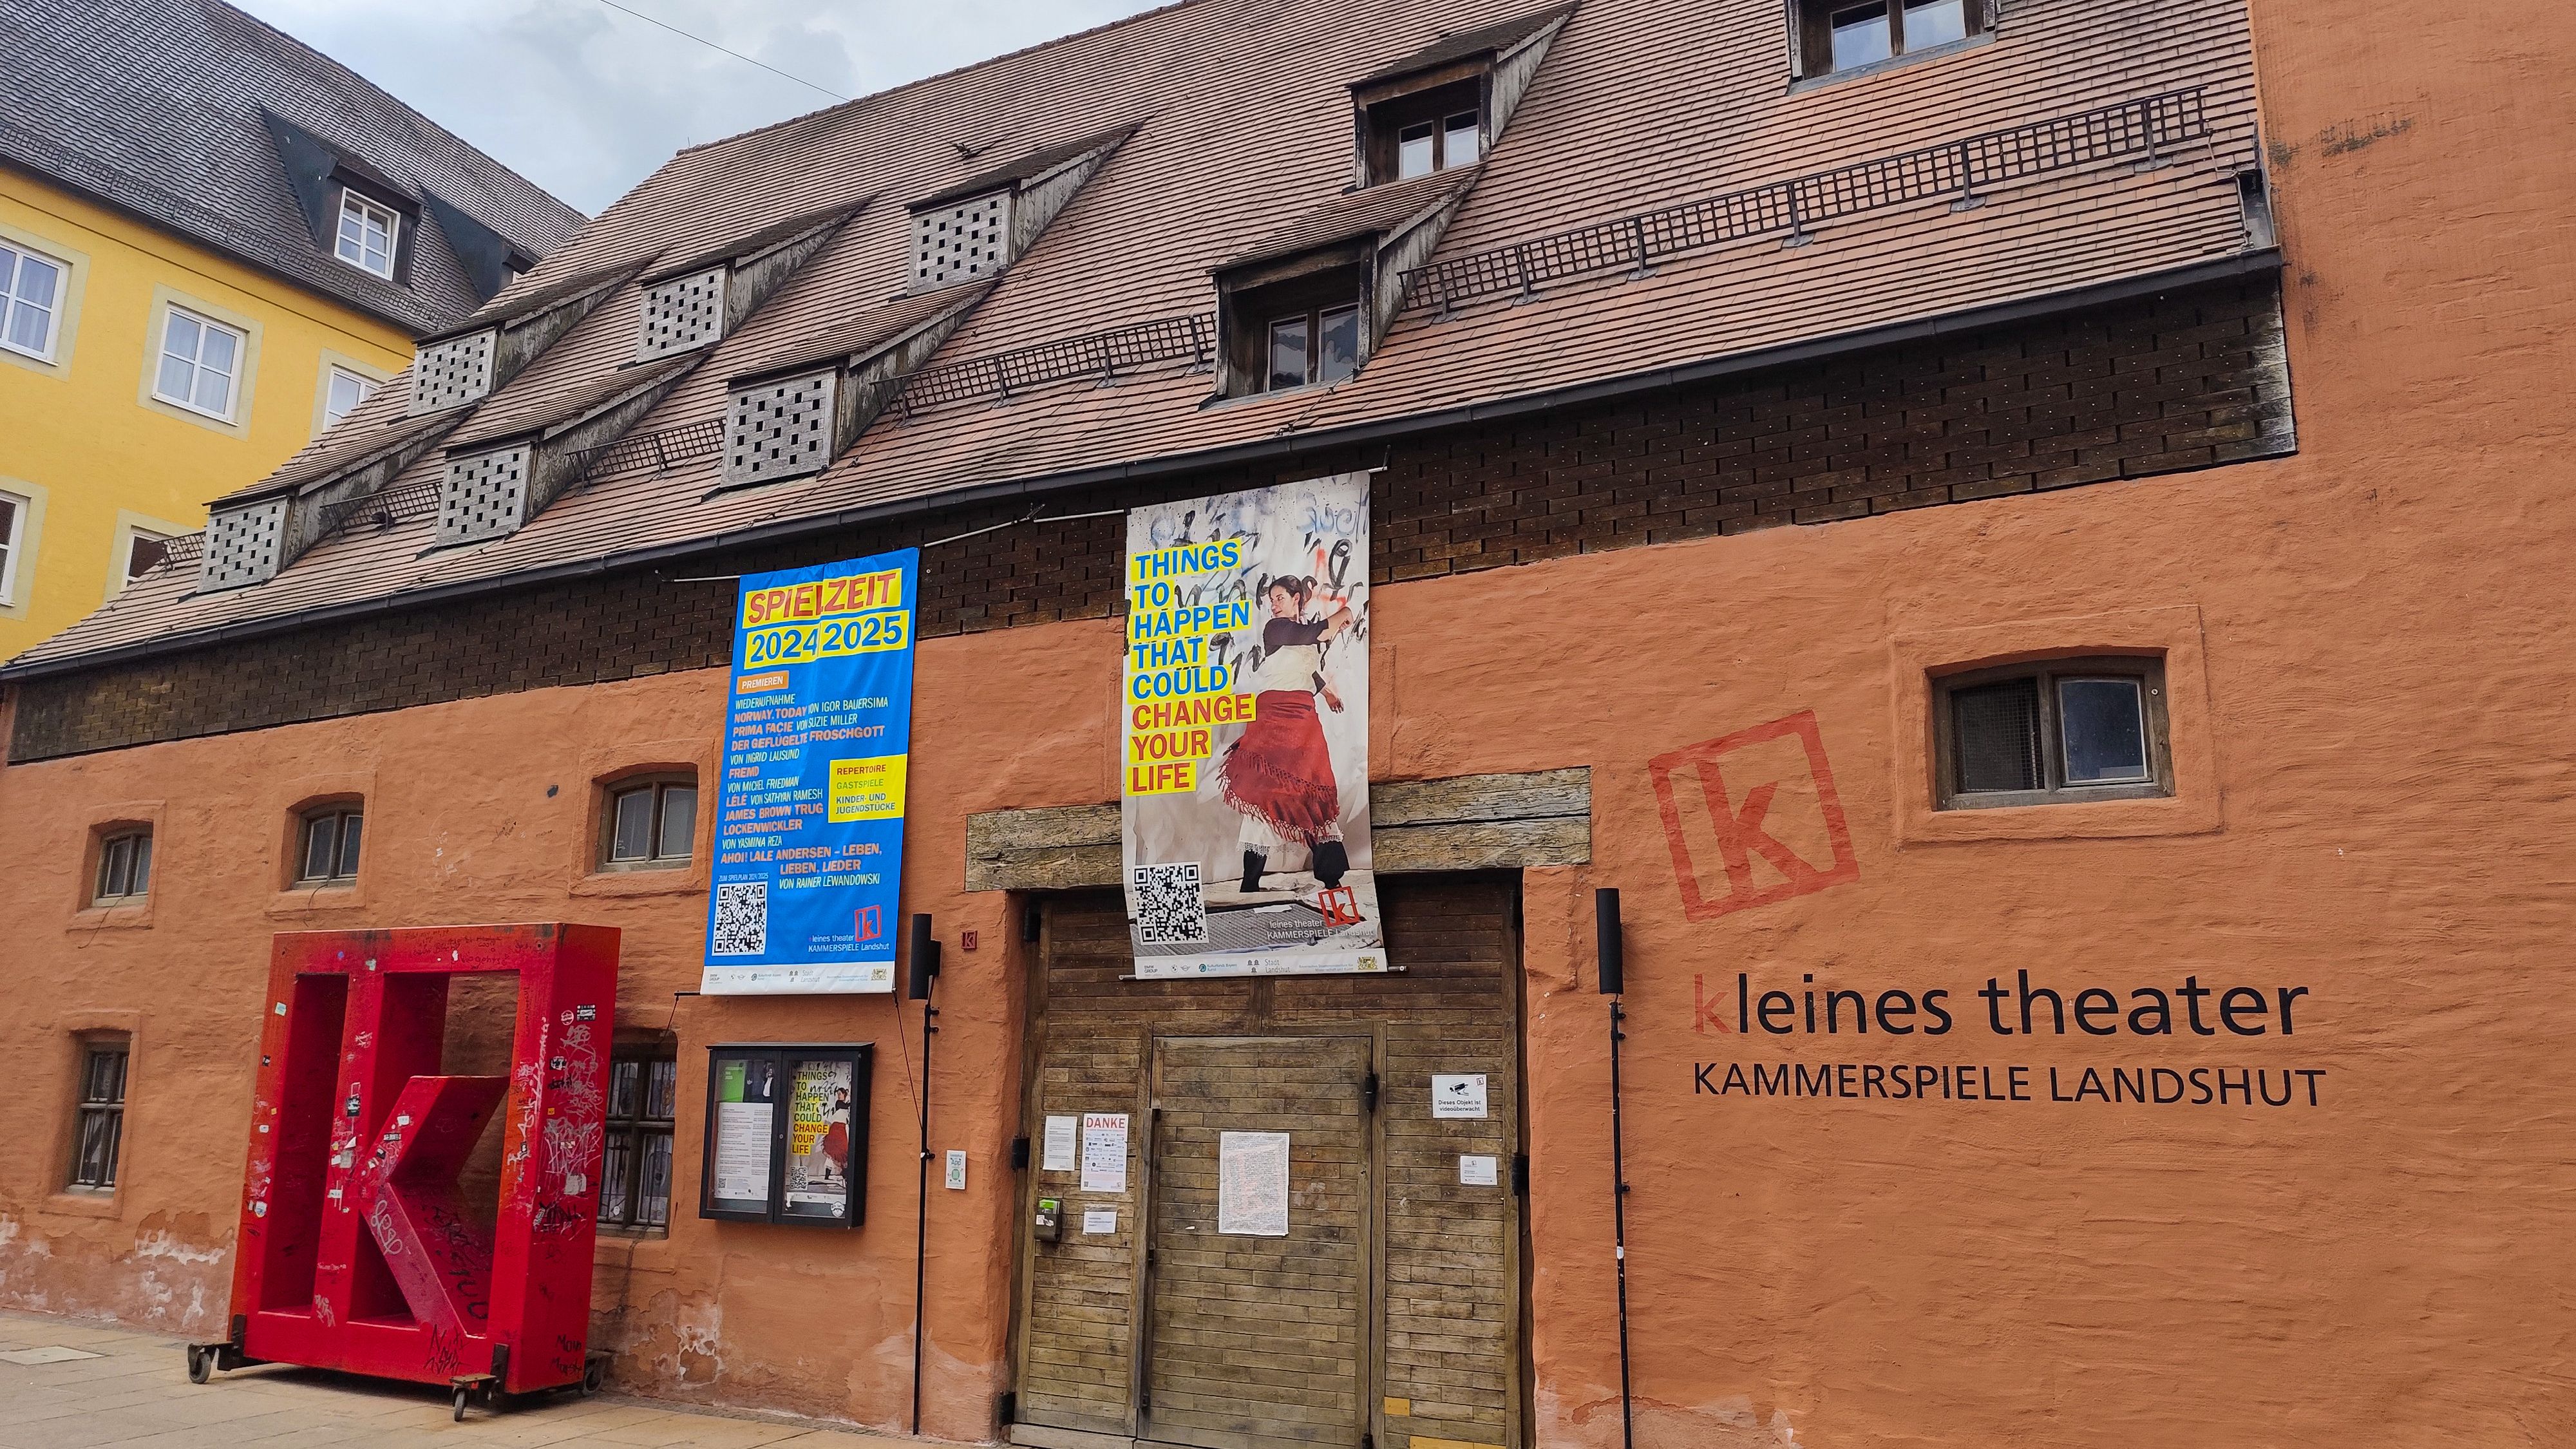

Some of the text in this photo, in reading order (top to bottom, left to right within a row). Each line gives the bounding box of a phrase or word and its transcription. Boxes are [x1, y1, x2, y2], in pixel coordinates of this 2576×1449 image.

[1135, 542, 1239, 579] THINGS
[1135, 585, 1170, 609] TO
[1135, 601, 1249, 639] HAPPEN
[1133, 638, 1203, 668] THAT
[742, 676, 783, 689] PREMIEREN
[1133, 667, 1227, 699] COULD
[735, 694, 796, 710] WIEDERAUFNAHME
[821, 700, 840, 712] IGOR
[843, 697, 888, 710] BAUERSIMA
[1133, 694, 1252, 730] CHANGE
[733, 724, 763, 738] PRIMA
[765, 721, 792, 734] FACIE
[808, 715, 828, 728] SUZIE
[830, 714, 858, 726] MILLER
[731, 725, 886, 752] DER GEFLÜGELTE FROSCHGOTT
[1132, 730, 1209, 761] YOUR
[730, 748, 800, 765] VON INGRID LAUSUND
[728, 766, 759, 779] FREMD
[837, 764, 886, 775] REPERTOIRE
[1133, 763, 1190, 791] LIFE
[728, 776, 799, 793] VON MICHEL FRIEDMAN
[837, 779, 884, 789] GASTSPIELE
[750, 795, 762, 805] VON
[764, 791, 791, 804] SATHYAN
[793, 788, 823, 801] RAMESH
[836, 793, 886, 804] KINDER- UND
[724, 802, 823, 821] JAMES BROWN TRUG
[836, 802, 895, 814] JUGENDSTÜCKE
[724, 819, 802, 836] LOCKENWICKLER
[722, 835, 782, 849] VON YASMINA REZA
[721, 852, 748, 864] AHOI!
[750, 850, 773, 862] LALE
[776, 846, 831, 860] ANDERSEN
[843, 843, 882, 855] LEBEN,
[780, 859, 861, 875] LIEBEN, LIEDER
[779, 873, 880, 889] VON RAINER LEWANDOWSKI
[1295, 919, 1323, 928] theater
[1267, 929, 1373, 940] KAMMERSPIELE Landshut
[808, 942, 889, 952] KAMMERSPIELE Landshut
[1694, 969, 2309, 1036] kleines theater
[797, 1072, 828, 1081] THINGS
[1694, 1062, 2327, 1107] KAMMERSPIELE LANDSHUT
[797, 1082, 806, 1090] TO
[796, 1092, 829, 1101] HAPPEN
[795, 1103, 816, 1112] THAT
[794, 1113, 822, 1122] COULD
[1086, 1117, 1125, 1128] DANKE
[793, 1124, 828, 1133] CHANGE
[793, 1133, 815, 1143] YOUR
[792, 1145, 809, 1153] LIFE
